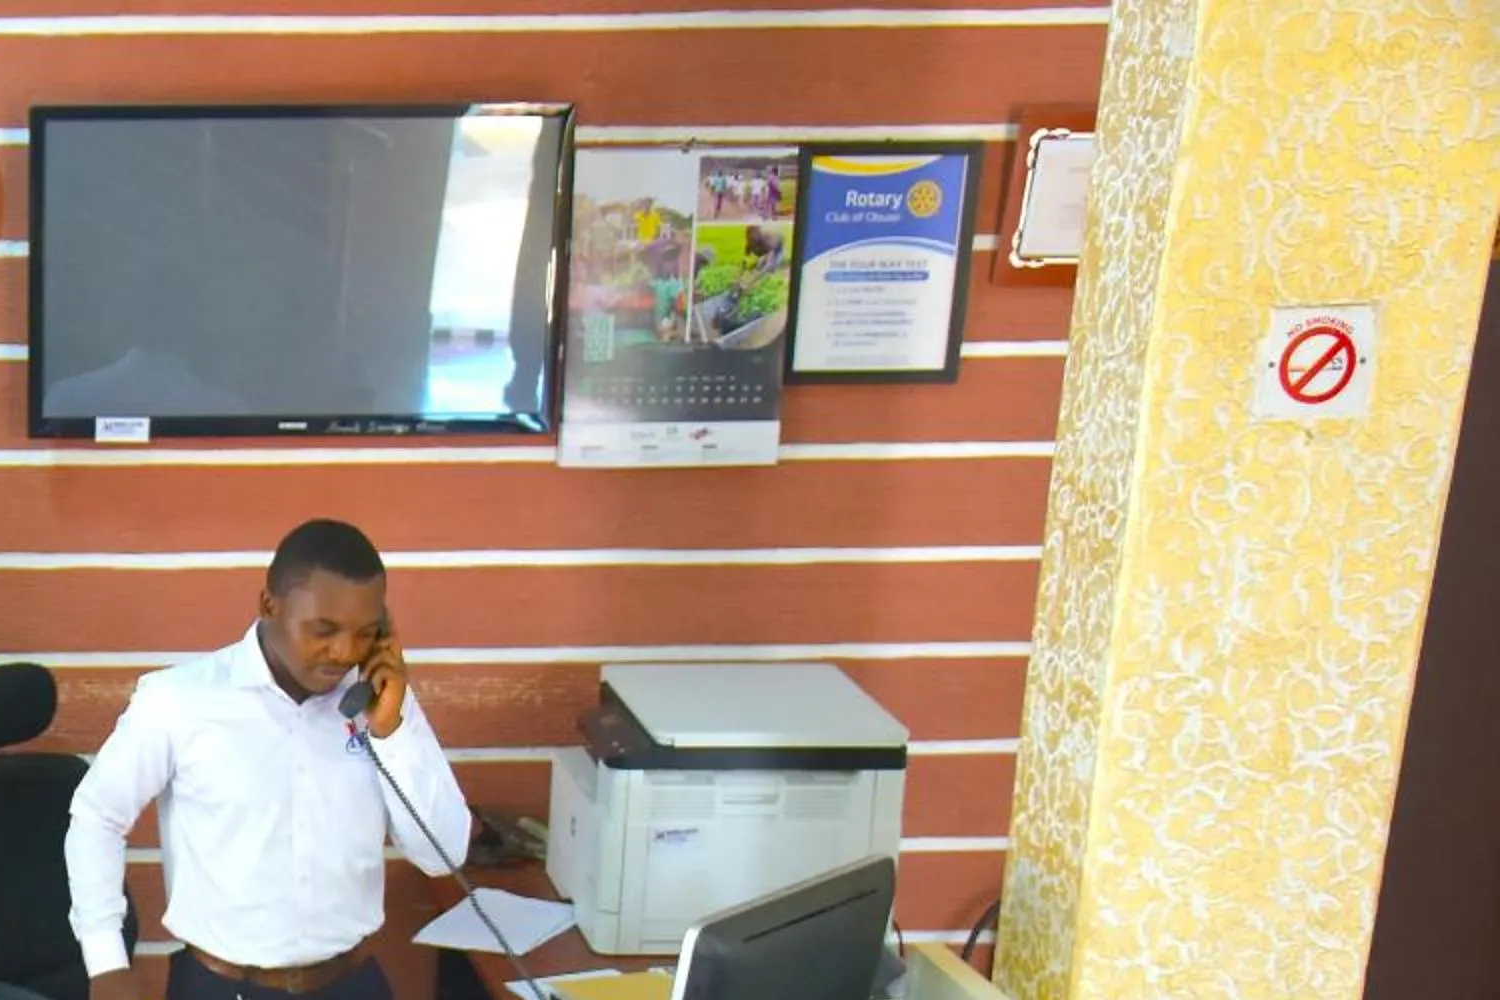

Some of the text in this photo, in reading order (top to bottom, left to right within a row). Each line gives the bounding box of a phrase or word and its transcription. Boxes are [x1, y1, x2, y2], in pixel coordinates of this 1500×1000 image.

[845, 189, 903, 210] Rotary
[1285, 315, 1355, 337] NO SMOKING
